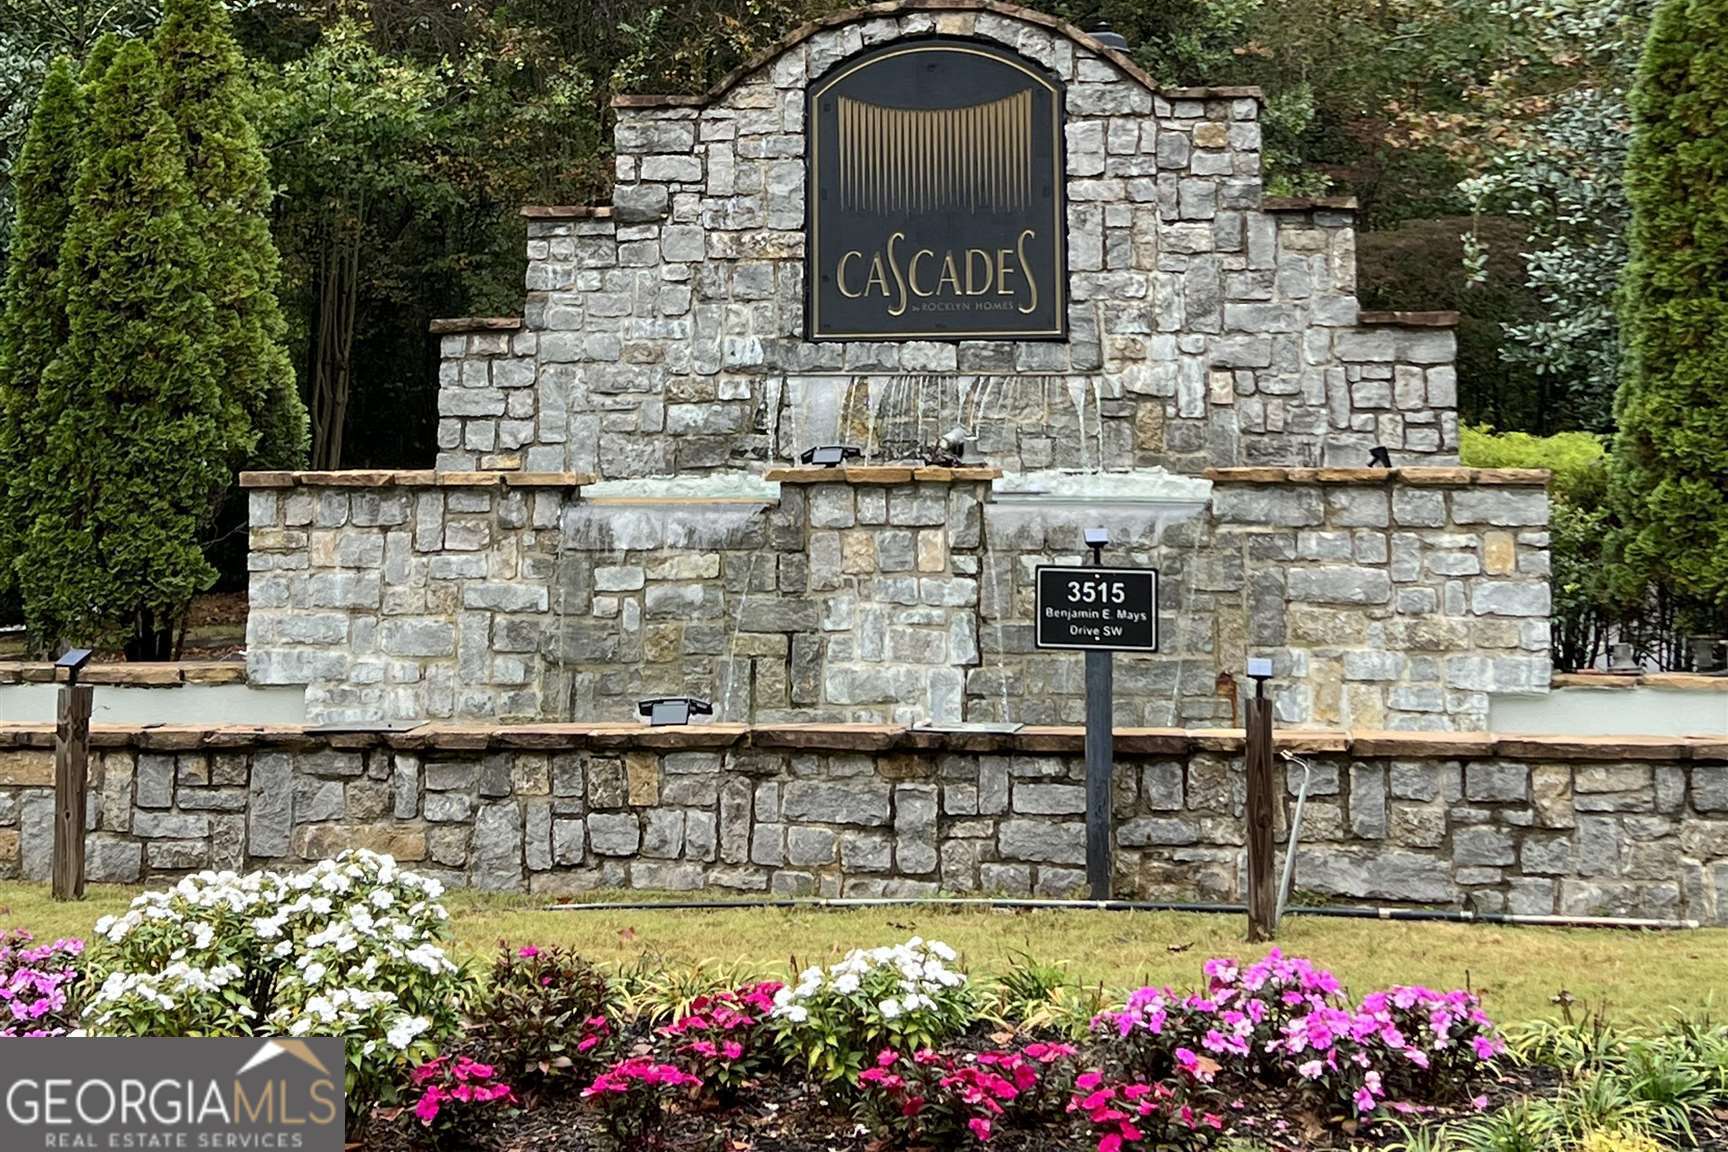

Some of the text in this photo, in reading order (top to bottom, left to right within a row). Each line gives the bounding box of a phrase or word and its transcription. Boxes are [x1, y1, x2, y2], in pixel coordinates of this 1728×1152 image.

[836, 229, 1038, 316] CASCADES
[975, 301, 1015, 311] HOMES
[1067, 581, 1125, 603] 3515
[1045, 607, 1100, 621] Benjamin
[1116, 609, 1147, 623] Mays
[1069, 625, 1123, 637] Drive SW
